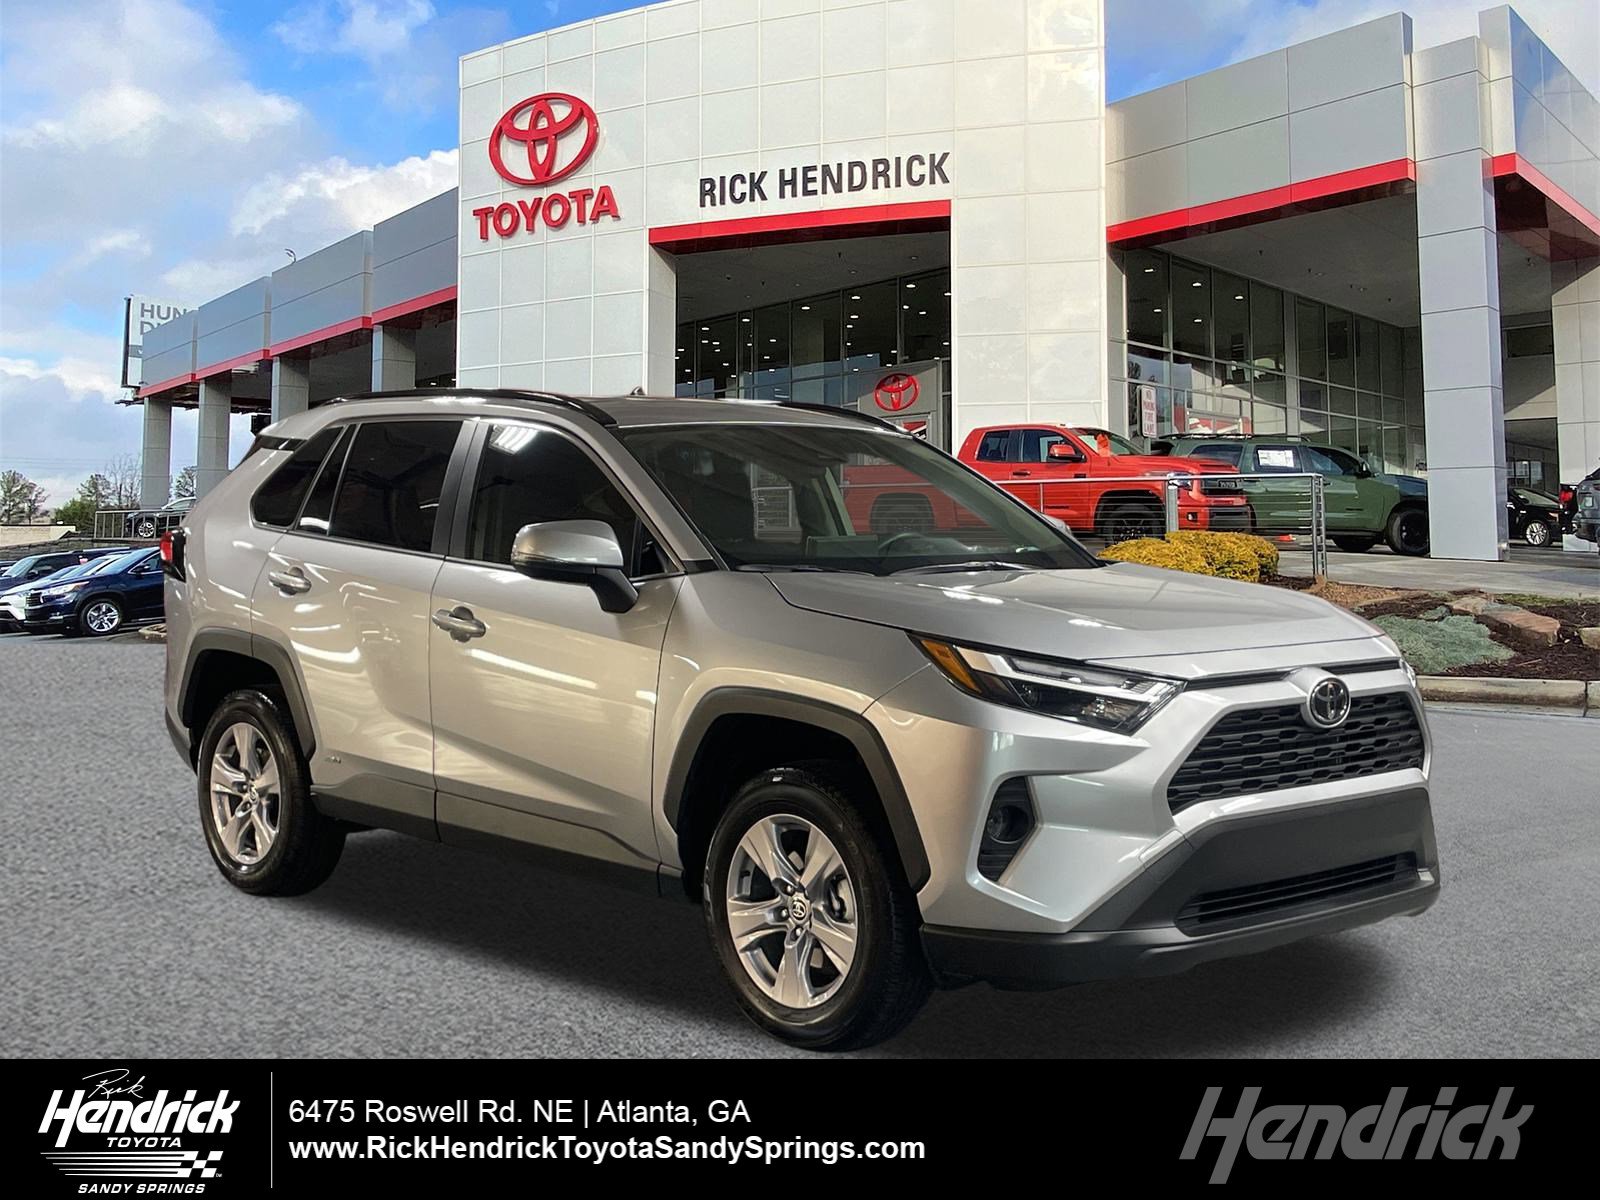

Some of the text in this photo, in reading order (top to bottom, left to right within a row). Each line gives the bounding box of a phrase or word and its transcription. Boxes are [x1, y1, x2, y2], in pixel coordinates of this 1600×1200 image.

[700, 152, 950, 208] RICK HENDRICK
[473, 185, 621, 241] TOYOTA
